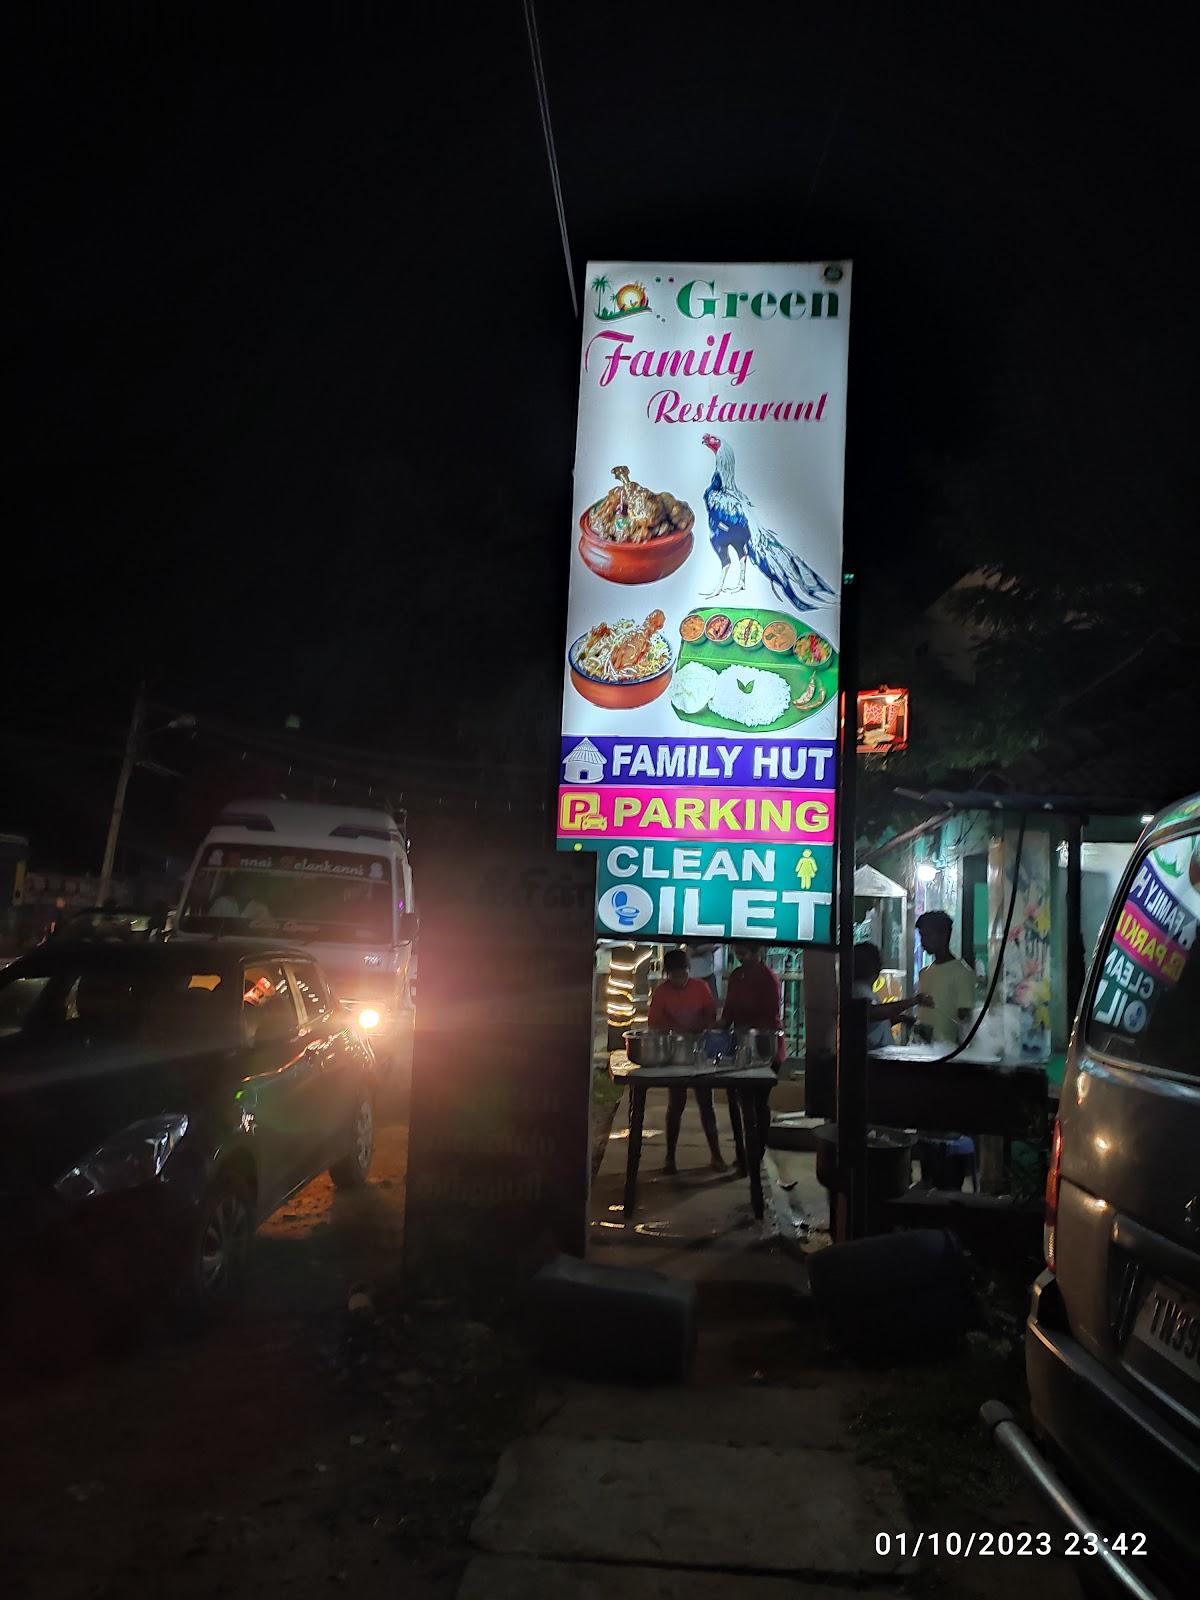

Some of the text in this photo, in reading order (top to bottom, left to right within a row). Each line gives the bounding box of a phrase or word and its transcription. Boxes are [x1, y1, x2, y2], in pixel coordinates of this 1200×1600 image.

[676, 279, 839, 320] Green
[585, 329, 757, 387] Family
[647, 389, 830, 424] Restaurant
[612, 744, 833, 781] FAMILY HUT
[613, 797, 830, 833] PARKING
[606, 845, 776, 882] CLEAN
